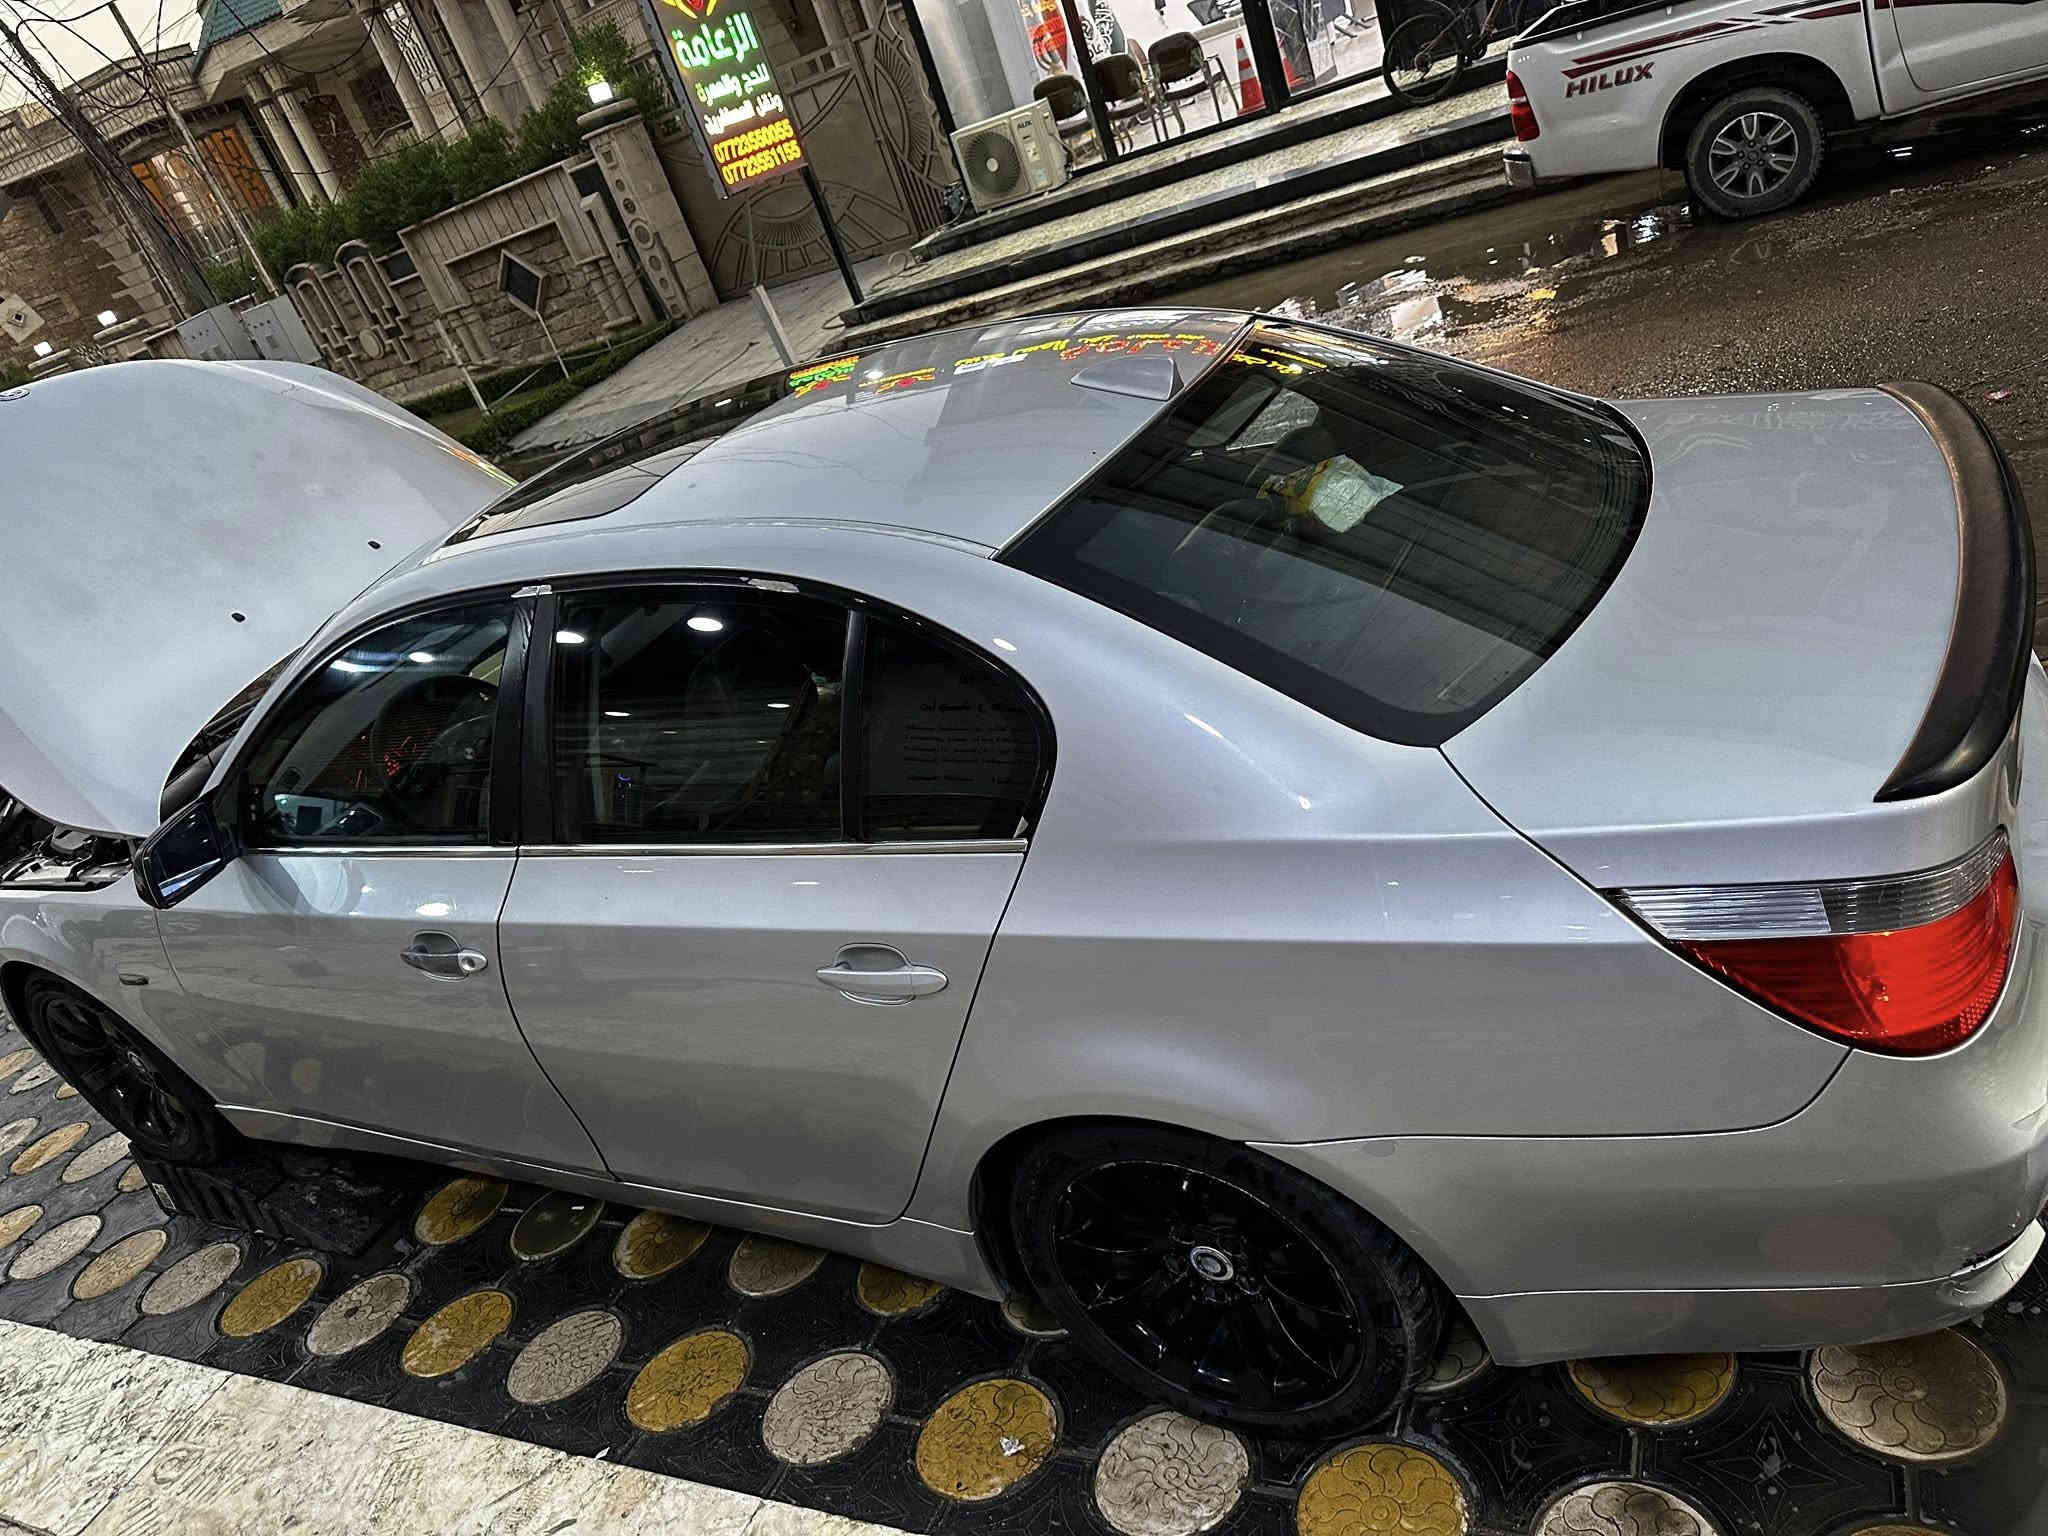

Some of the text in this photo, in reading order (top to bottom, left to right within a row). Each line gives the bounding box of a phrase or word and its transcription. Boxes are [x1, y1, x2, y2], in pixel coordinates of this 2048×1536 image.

[672, 12, 758, 67] الزعامة
[741, 63, 770, 93] للحج
[1566, 62, 1655, 97] HILUX
